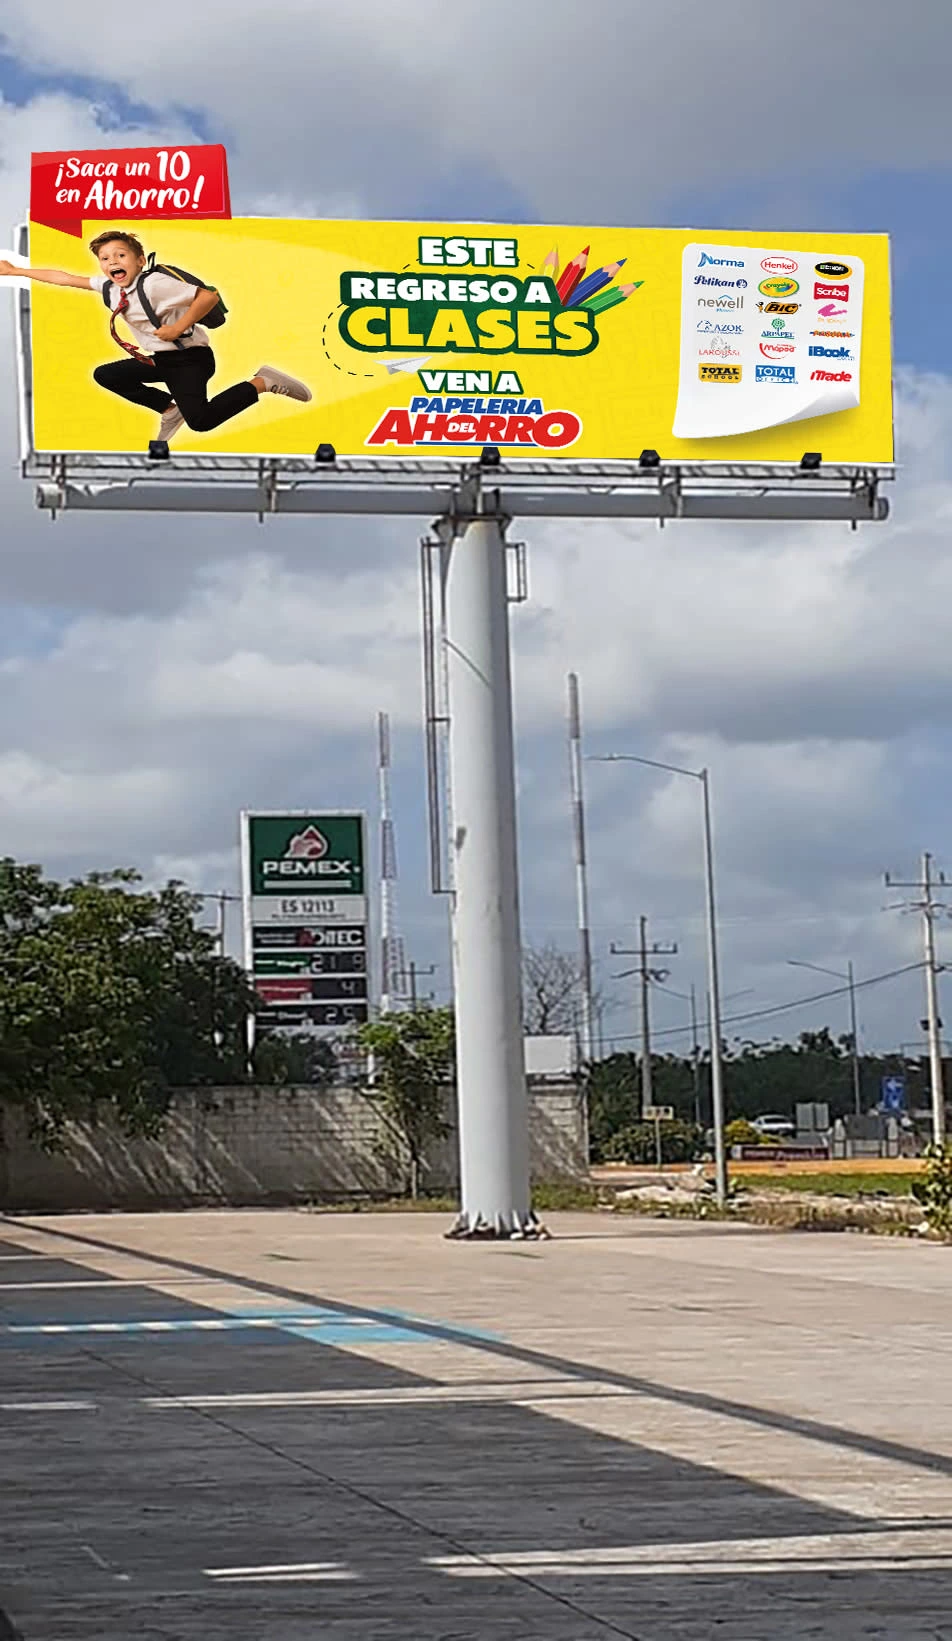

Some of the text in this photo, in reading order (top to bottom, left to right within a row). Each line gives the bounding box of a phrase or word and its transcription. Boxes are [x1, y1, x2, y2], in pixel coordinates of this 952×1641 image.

[54, 150, 192, 188] ¡Saca un 10
[55, 174, 206, 211] en Ahorro!
[420, 238, 518, 267] ESTE
[697, 252, 746, 269] Norma
[764, 260, 796, 271] Henkel
[693, 275, 736, 288] Pelikan
[349, 276, 553, 305] REGRESO A
[816, 286, 847, 298] Scribe
[697, 296, 744, 309] newell
[767, 303, 796, 313] BIC
[347, 307, 593, 351] CLASES
[758, 367, 794, 377] TOTAL
[420, 371, 521, 393] VEN A
[410, 396, 544, 416] PAPELERIA
[368, 410, 580, 447] AHORRO
[447, 421, 477, 434] DEL
[262, 861, 351, 874] PEMEX
[281, 899, 335, 914] ES 12113
